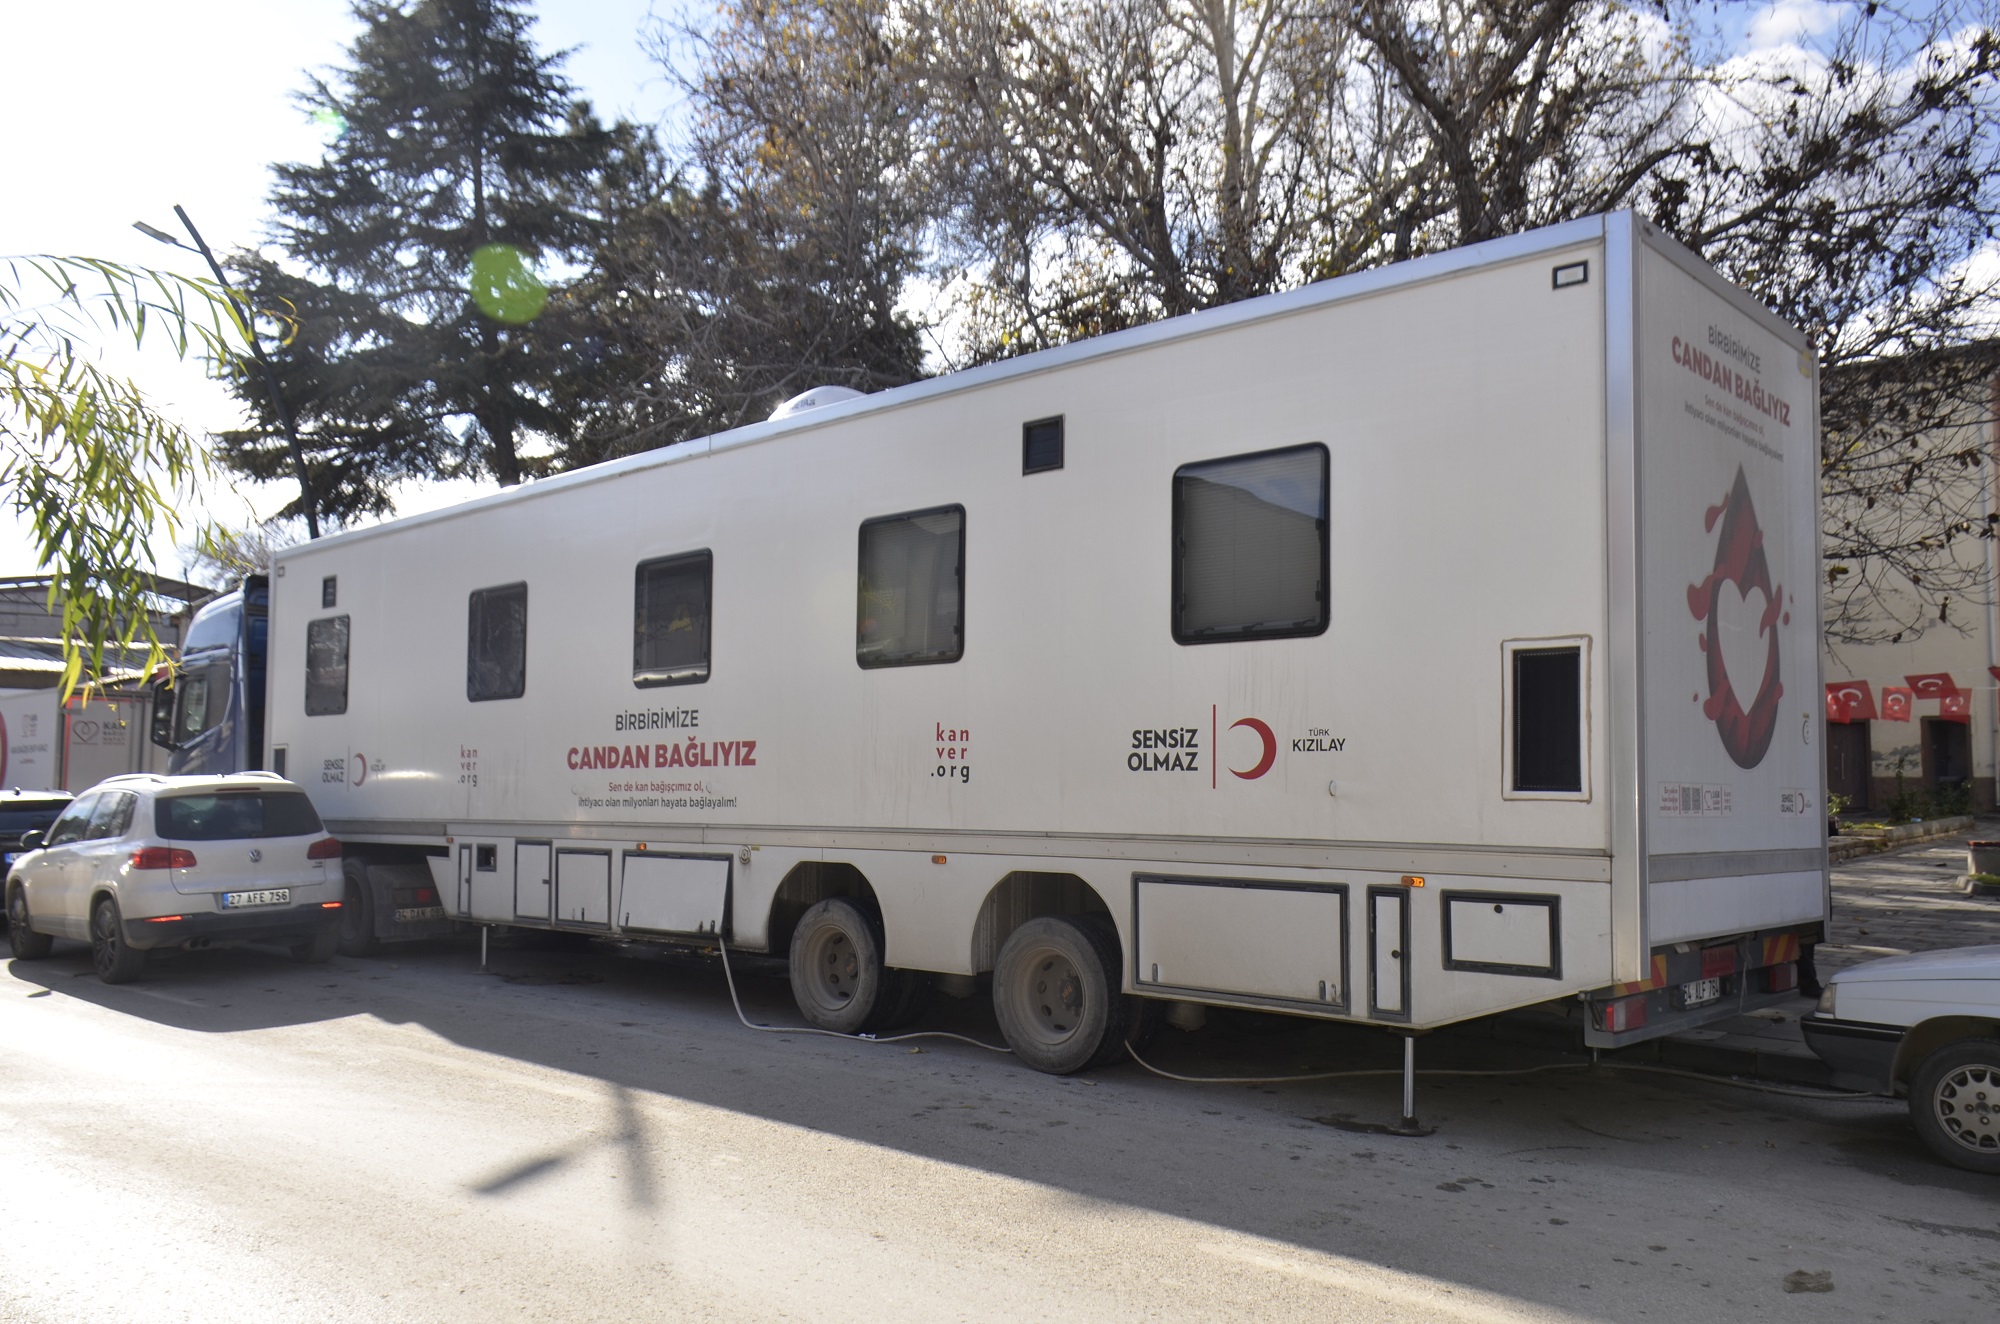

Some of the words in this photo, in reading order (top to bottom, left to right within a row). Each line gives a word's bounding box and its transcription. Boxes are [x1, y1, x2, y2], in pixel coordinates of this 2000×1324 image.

[1708, 324, 1761, 375] BİRBİRİMİZE
[1671, 336, 1732, 394] CANDAN
[1735, 377, 1790, 428] BAĞLIYIZ
[615, 706, 699, 731] BİRBİRİMİZE
[936, 722, 970, 742] kan
[1308, 728, 1331, 737] TÜRK
[461, 744, 478, 758] kan
[1292, 738, 1346, 752] KIZILAY
[567, 744, 650, 771] CANDAN
[655, 736, 757, 768] BAĞLIYIZ
[936, 747, 968, 760] ver
[461, 762, 477, 770] ver
[1127, 751, 1199, 772] OLMAZ
[322, 771, 344, 783] OLMAZ
[458, 774, 478, 787] .org
[931, 765, 970, 783] .org
[608, 782, 622, 792] Sen
[624, 782, 633, 792] de
[635, 781, 649, 792] kan
[650, 781, 691, 793] bağışçımız
[694, 781, 704, 792] ol,
[605, 797, 621, 807] olan
[622, 796, 659, 809] milyonları
[661, 797, 687, 809] hayata
[690, 796, 737, 809] bağlayalım!
[229, 894, 241, 905] 27
[247, 892, 265, 903] AFE
[269, 891, 287, 902] 756
